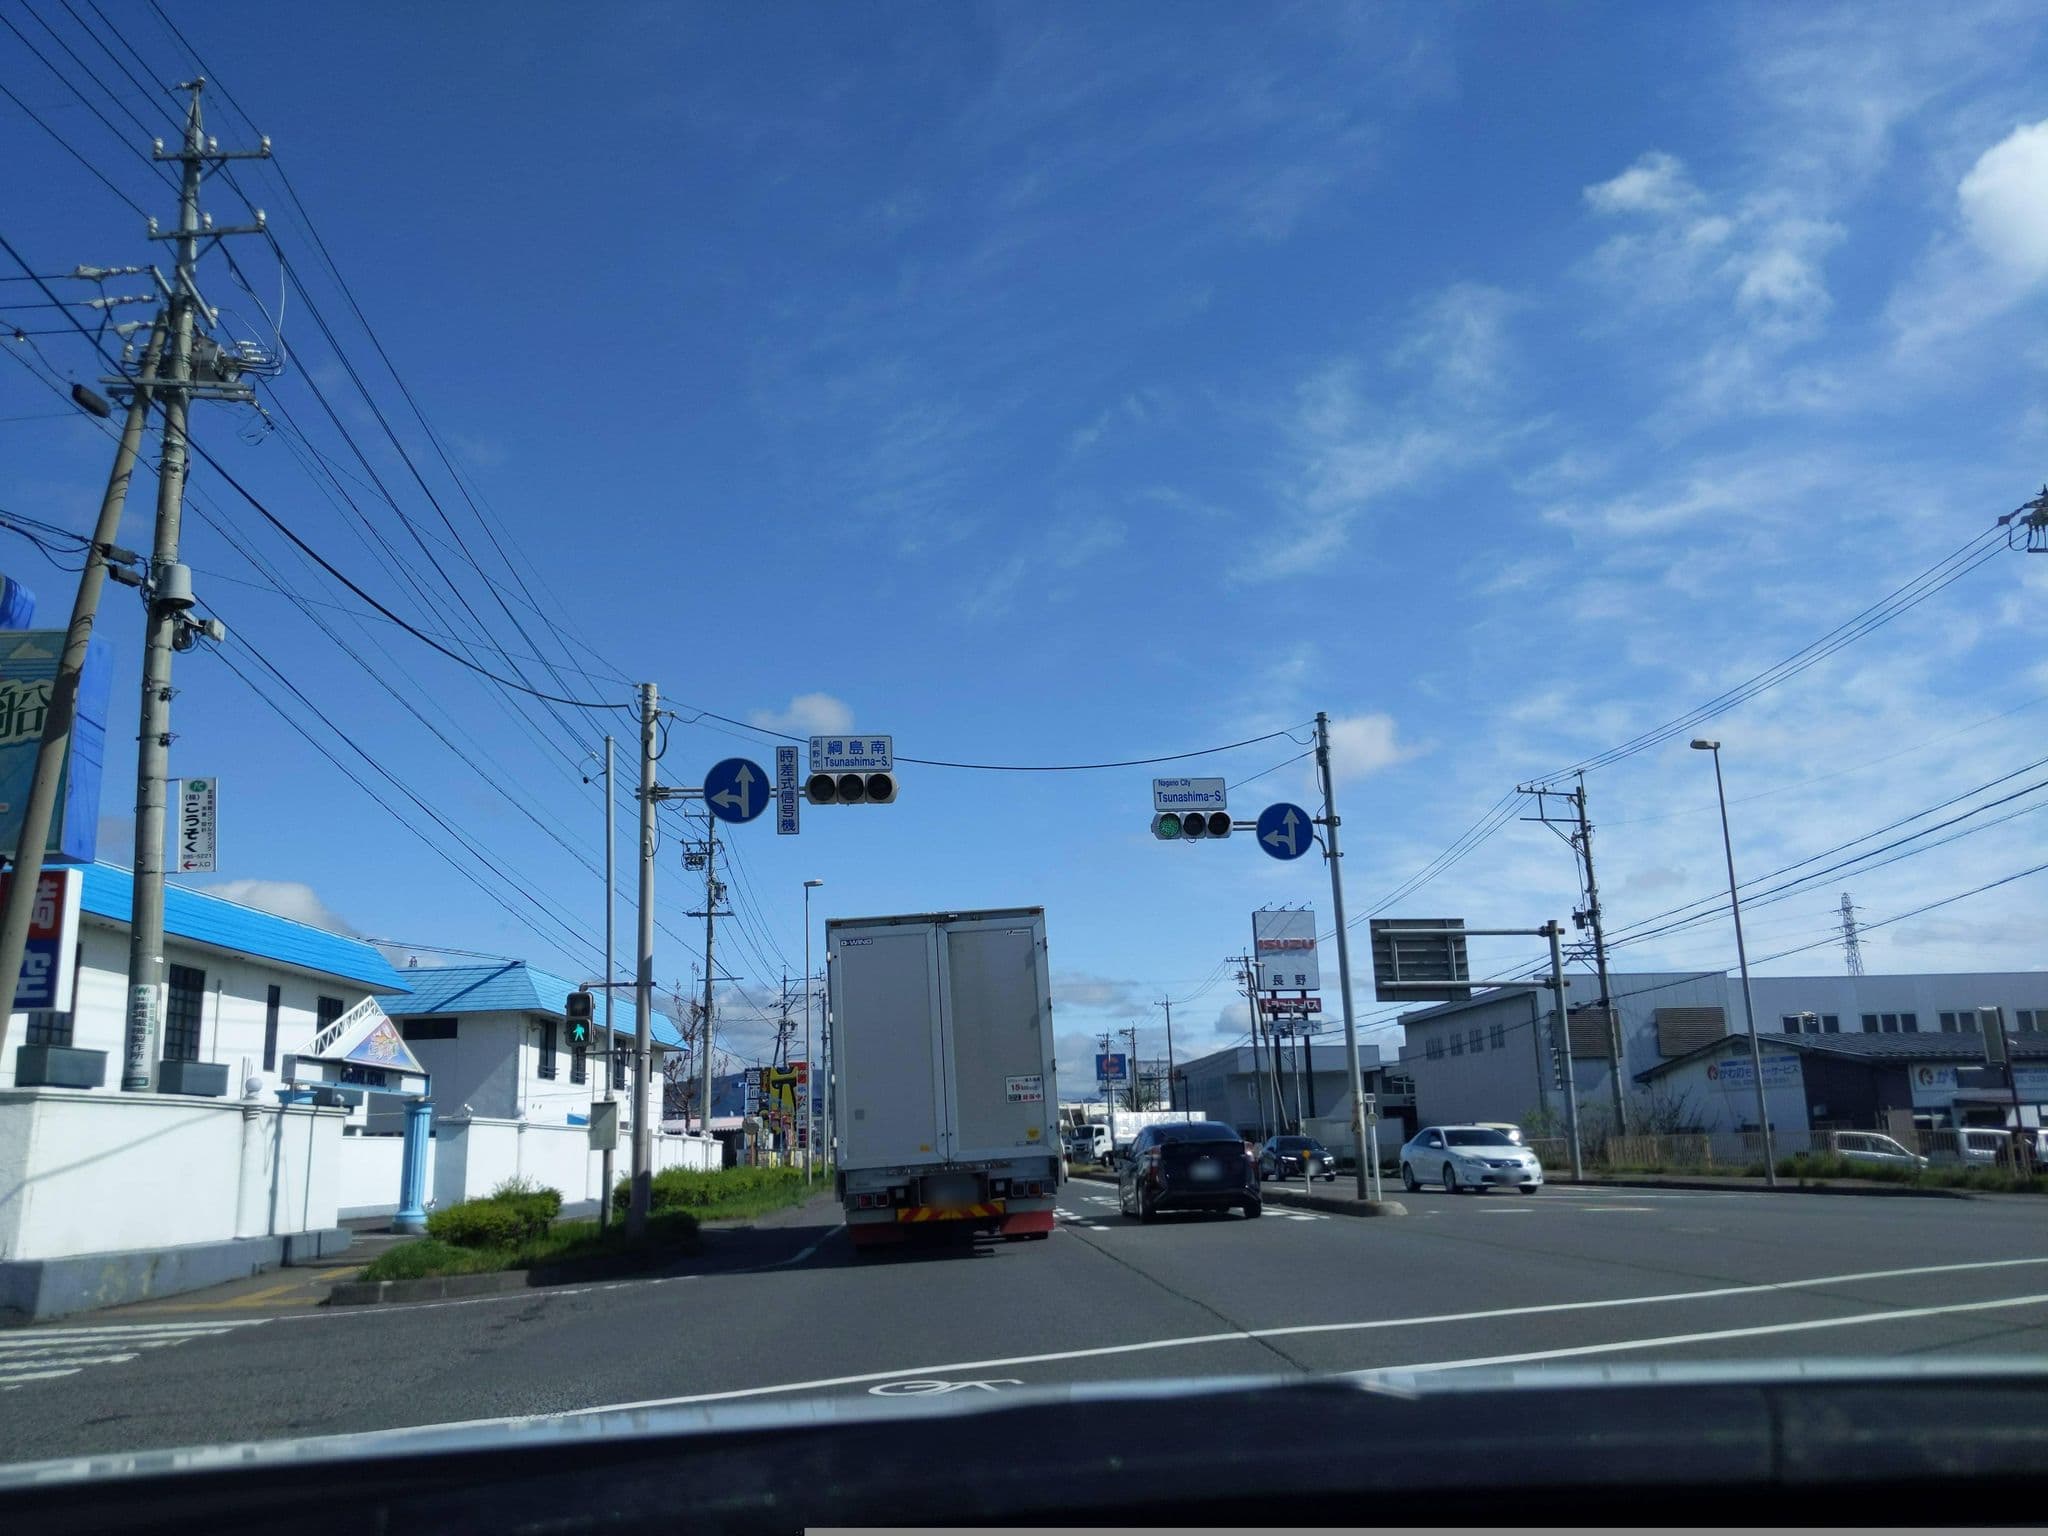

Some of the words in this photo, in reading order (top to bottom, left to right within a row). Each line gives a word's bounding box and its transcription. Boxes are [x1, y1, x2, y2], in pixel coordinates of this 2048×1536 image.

[827, 740, 886, 755] 綱島南
[824, 757, 890, 768] Tsunashima-S.
[780, 750, 797, 832] 時差式信号機
[1157, 790, 1224, 803] Tsunashima-S.
[1258, 938, 1315, 950] ISUZU
[1273, 975, 1306, 986] 長野
